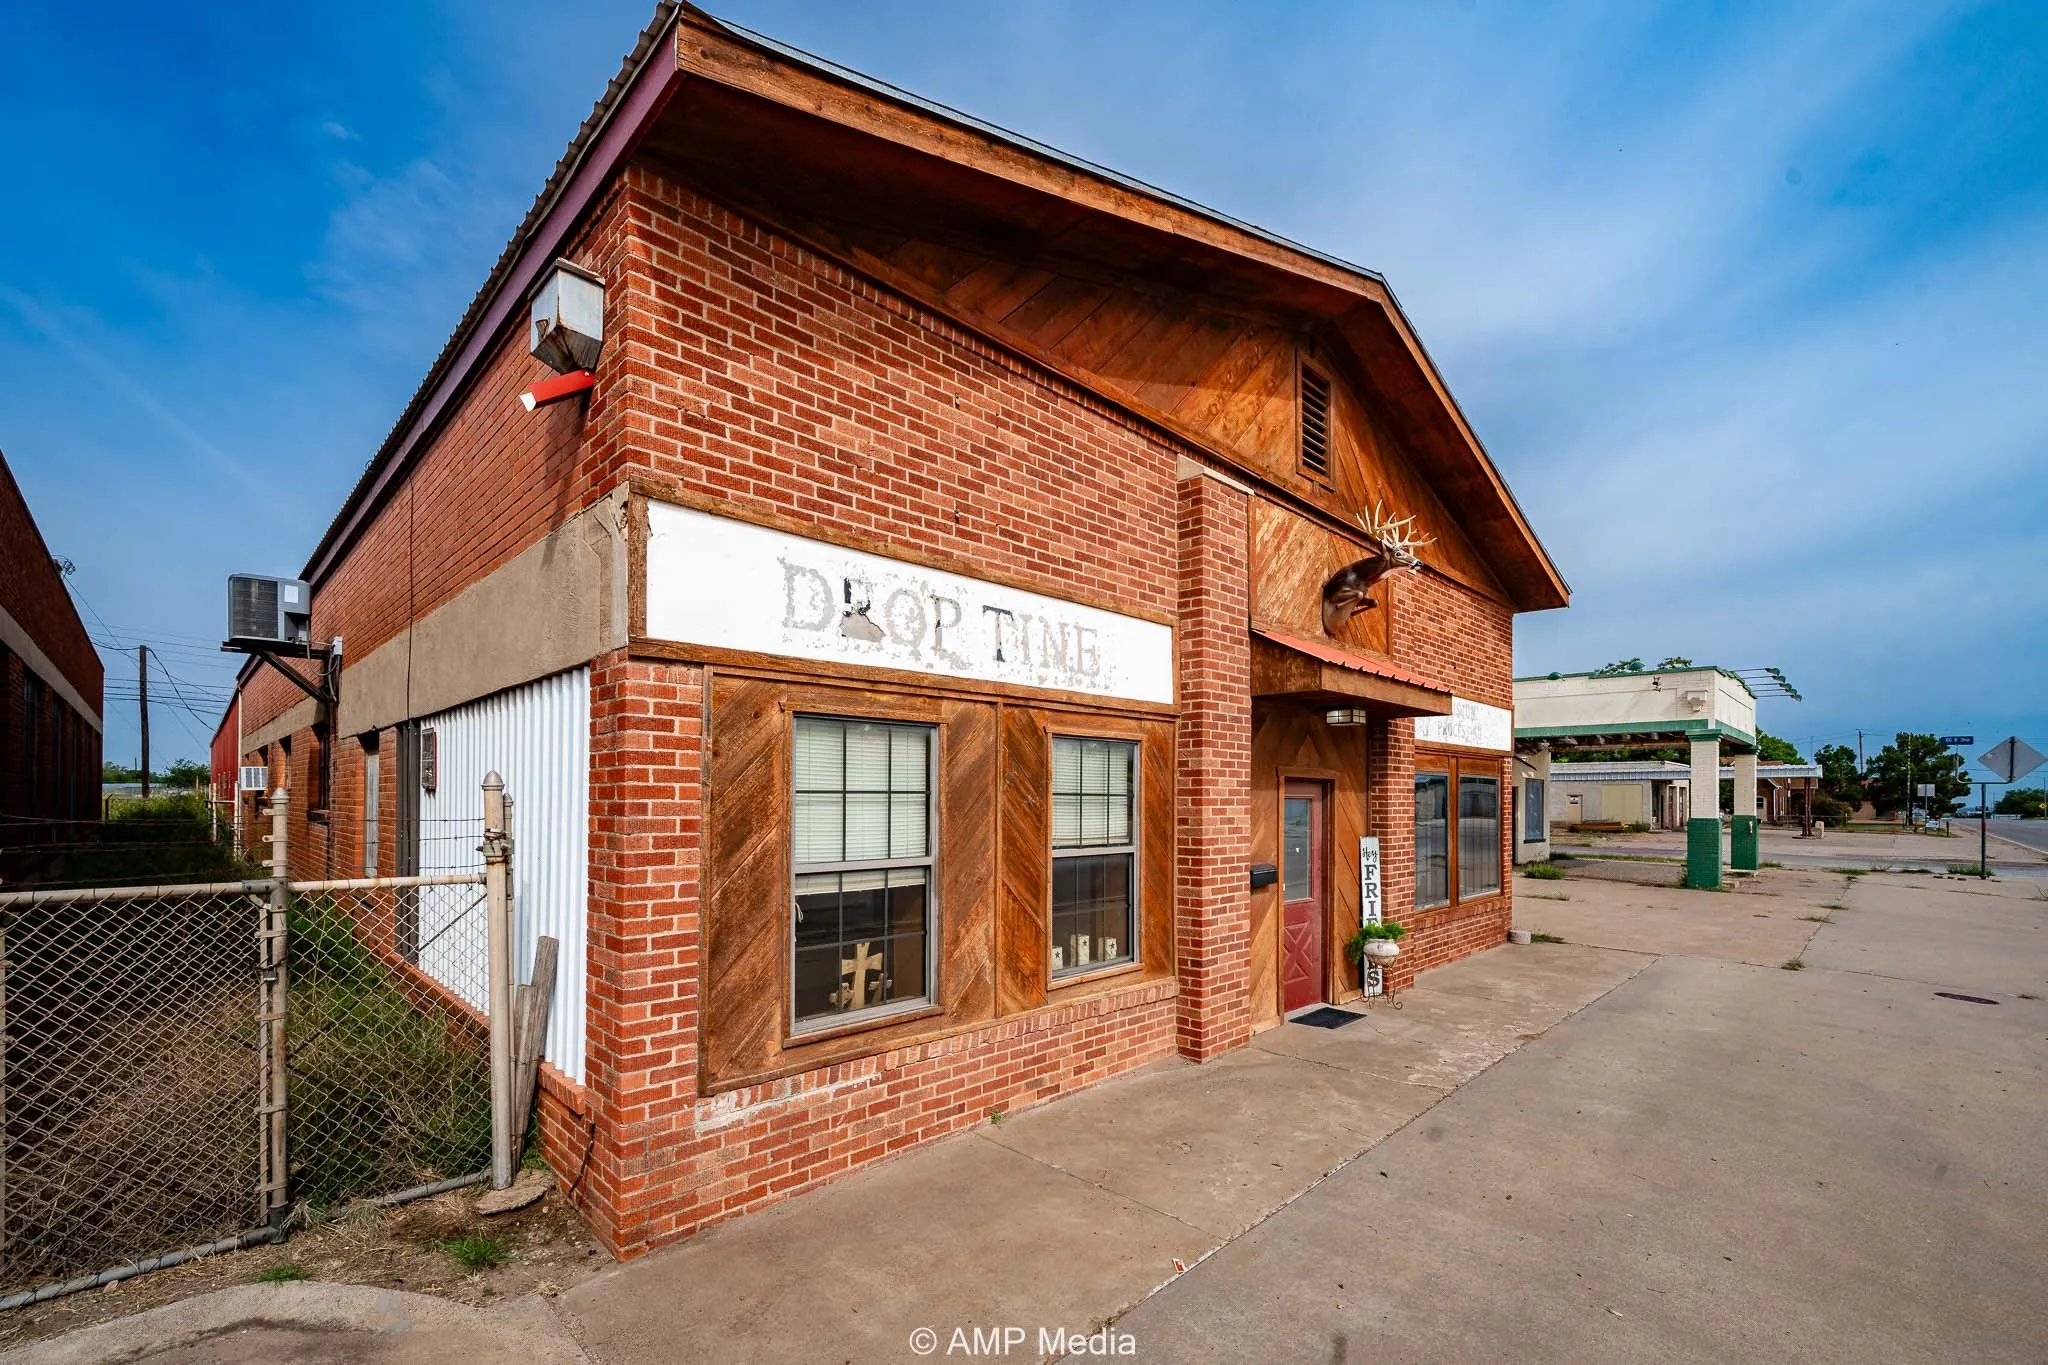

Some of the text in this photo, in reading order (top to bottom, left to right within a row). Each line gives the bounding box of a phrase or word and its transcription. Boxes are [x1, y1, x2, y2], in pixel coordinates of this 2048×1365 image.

[982, 605, 1101, 677] TINE
[1362, 846, 1378, 864] Hey
[1364, 864, 1380, 988] FRIS
